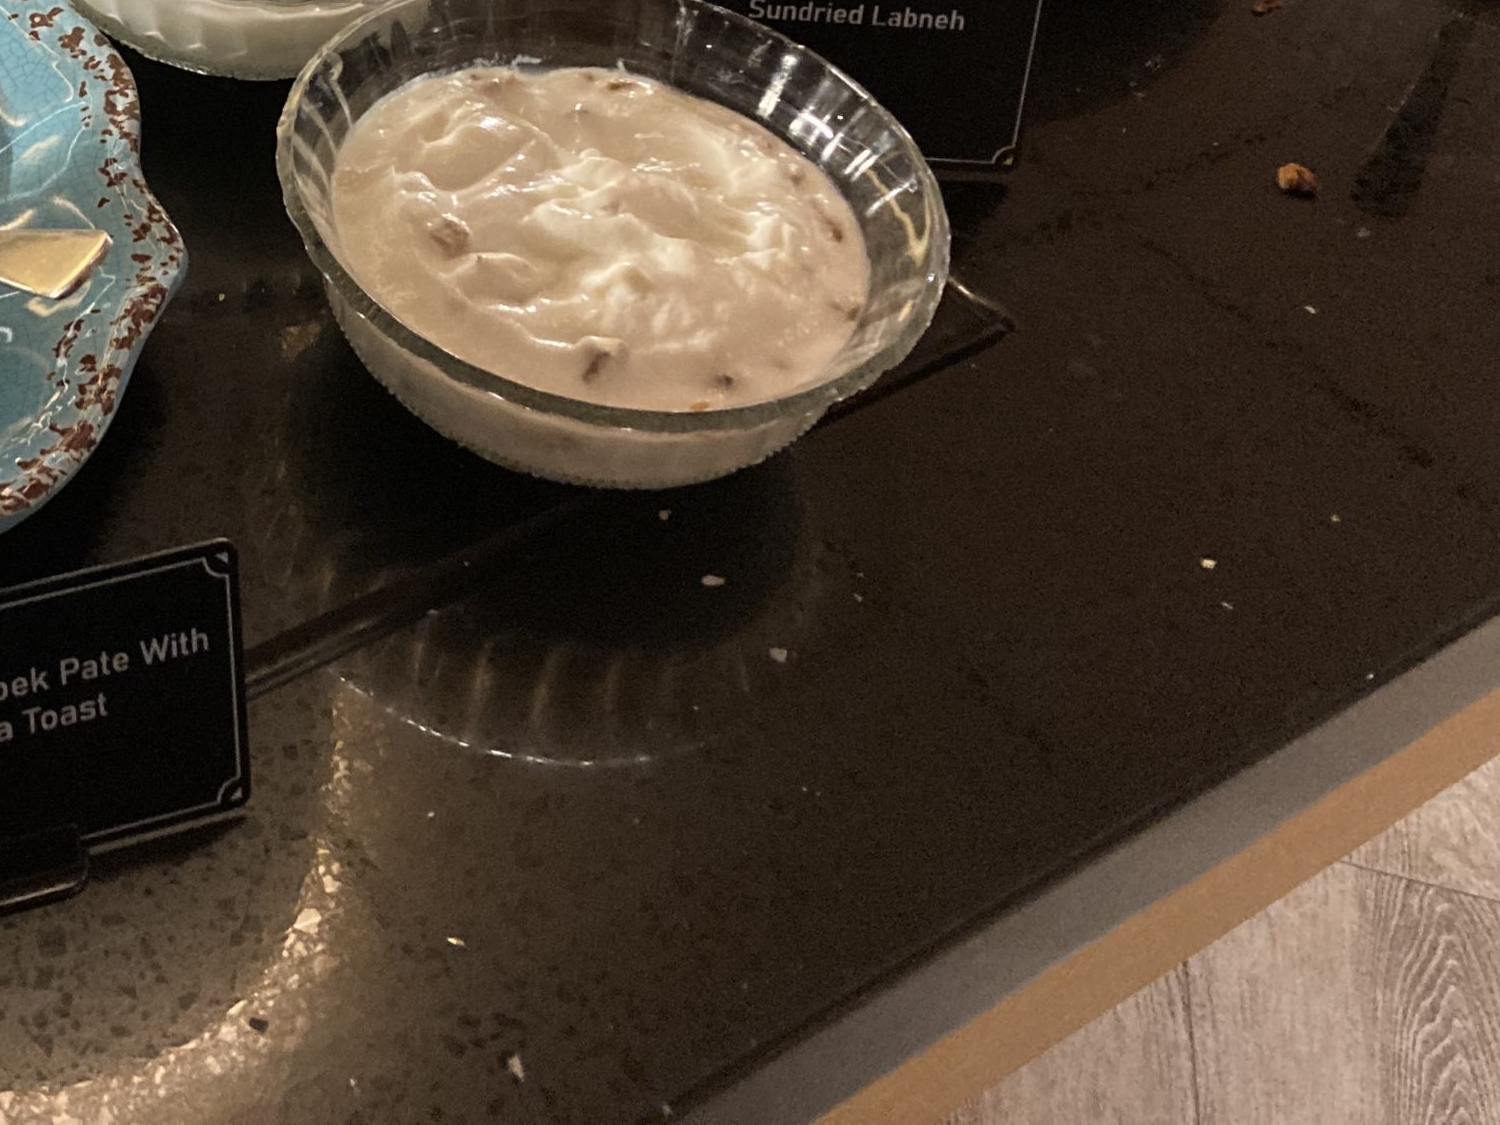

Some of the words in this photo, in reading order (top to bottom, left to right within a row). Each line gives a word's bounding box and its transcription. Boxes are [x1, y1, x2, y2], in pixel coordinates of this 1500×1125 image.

[872, 5, 965, 30] Labneh
[60, 651, 130, 686] Pate
[139, 627, 210, 666] With
[22, 692, 108, 735] Toast
